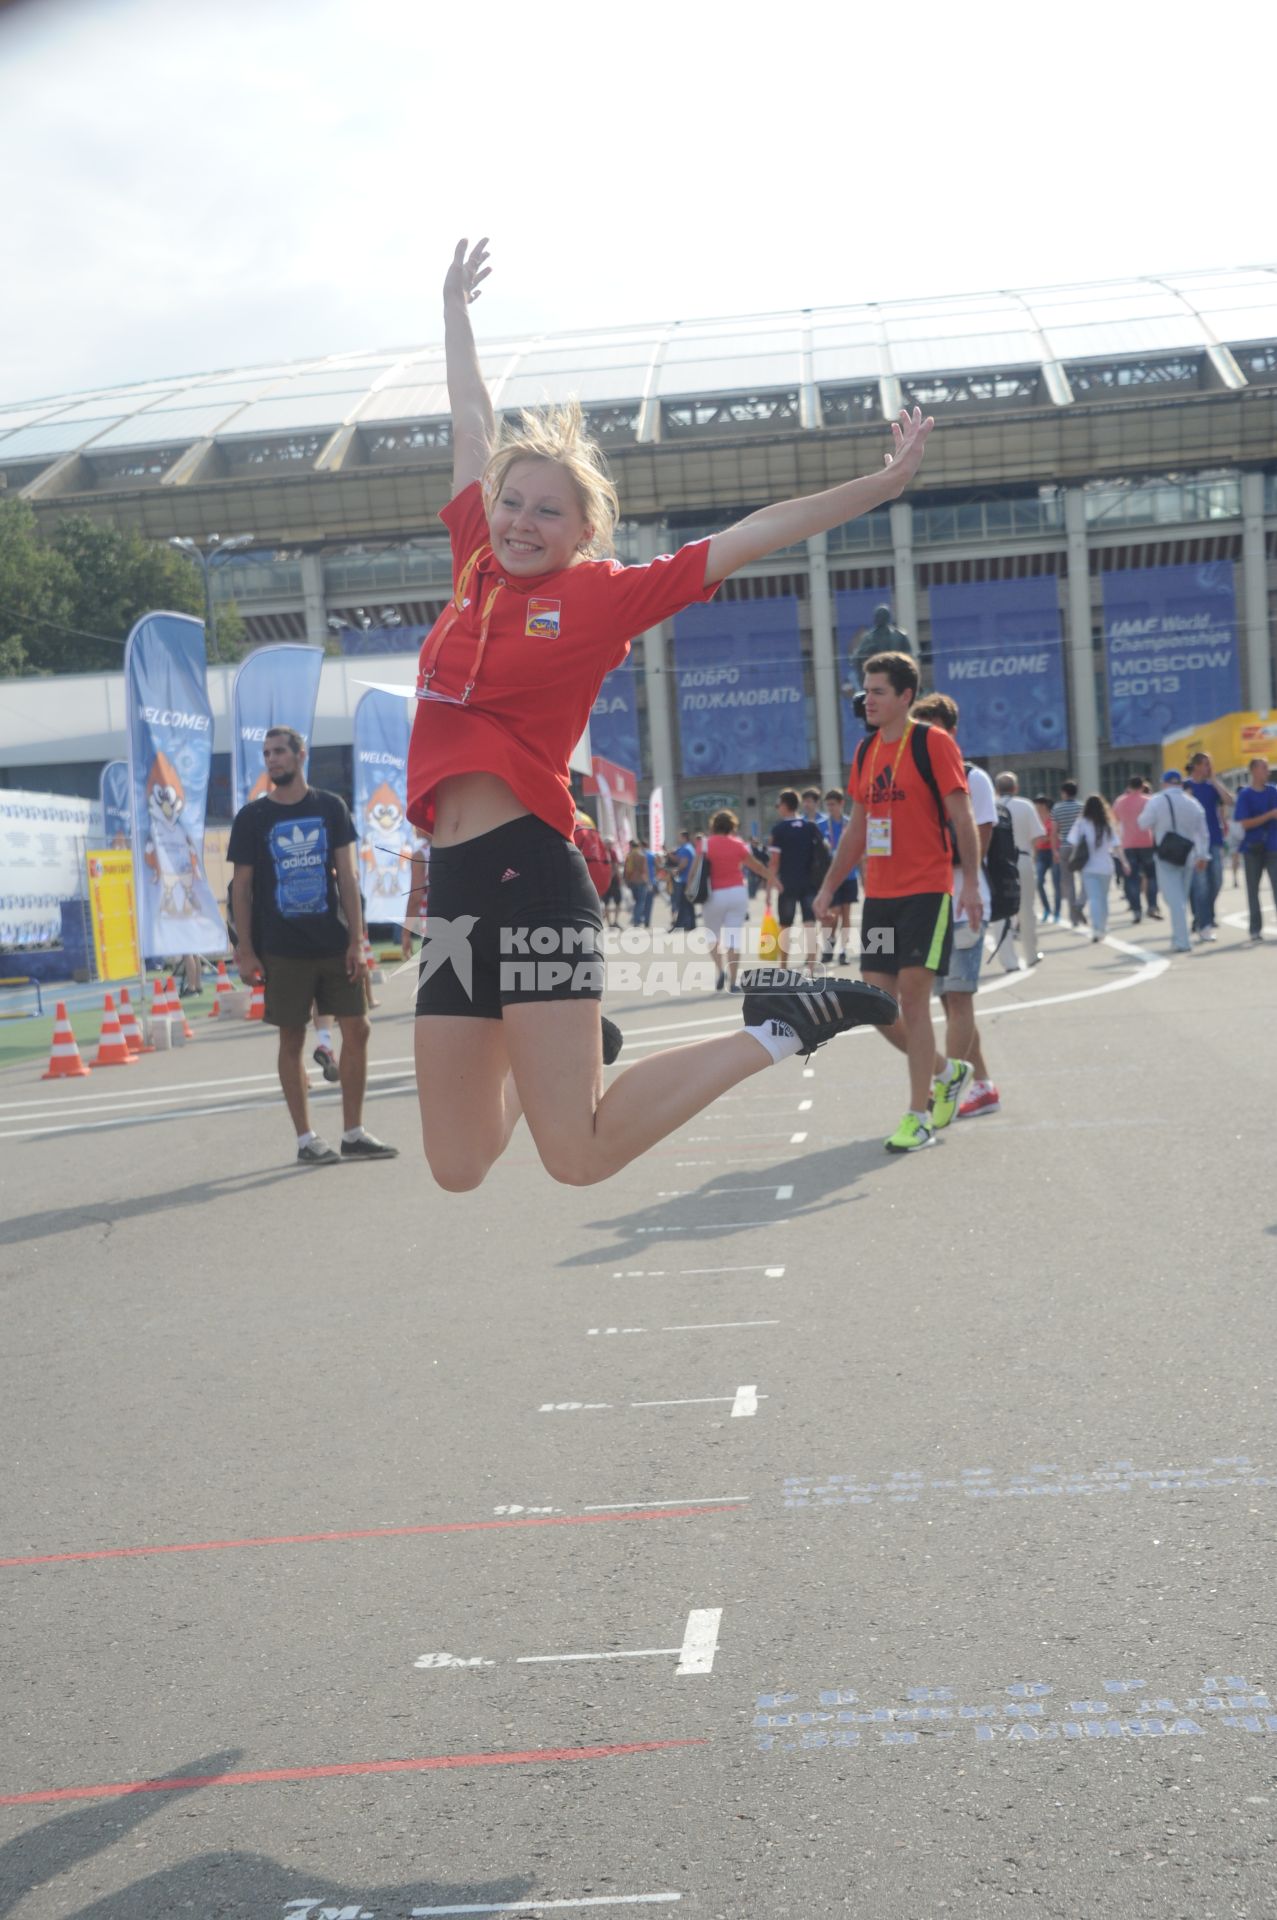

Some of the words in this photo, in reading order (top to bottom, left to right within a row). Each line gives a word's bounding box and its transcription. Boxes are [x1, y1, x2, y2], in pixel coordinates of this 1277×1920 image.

[1109, 617, 1159, 637] IAAF
[1161, 613, 1211, 632] World
[1110, 629, 1231, 653] Championships
[949, 653, 1049, 680] WELCOME
[1111, 651, 1232, 677] MOSCOW
[680, 668, 739, 688] ДОБРО
[1113, 676, 1180, 697] 2013
[683, 686, 800, 711] ПОЖАЛОВАТЬ
[281, 855, 322, 870] adidas
